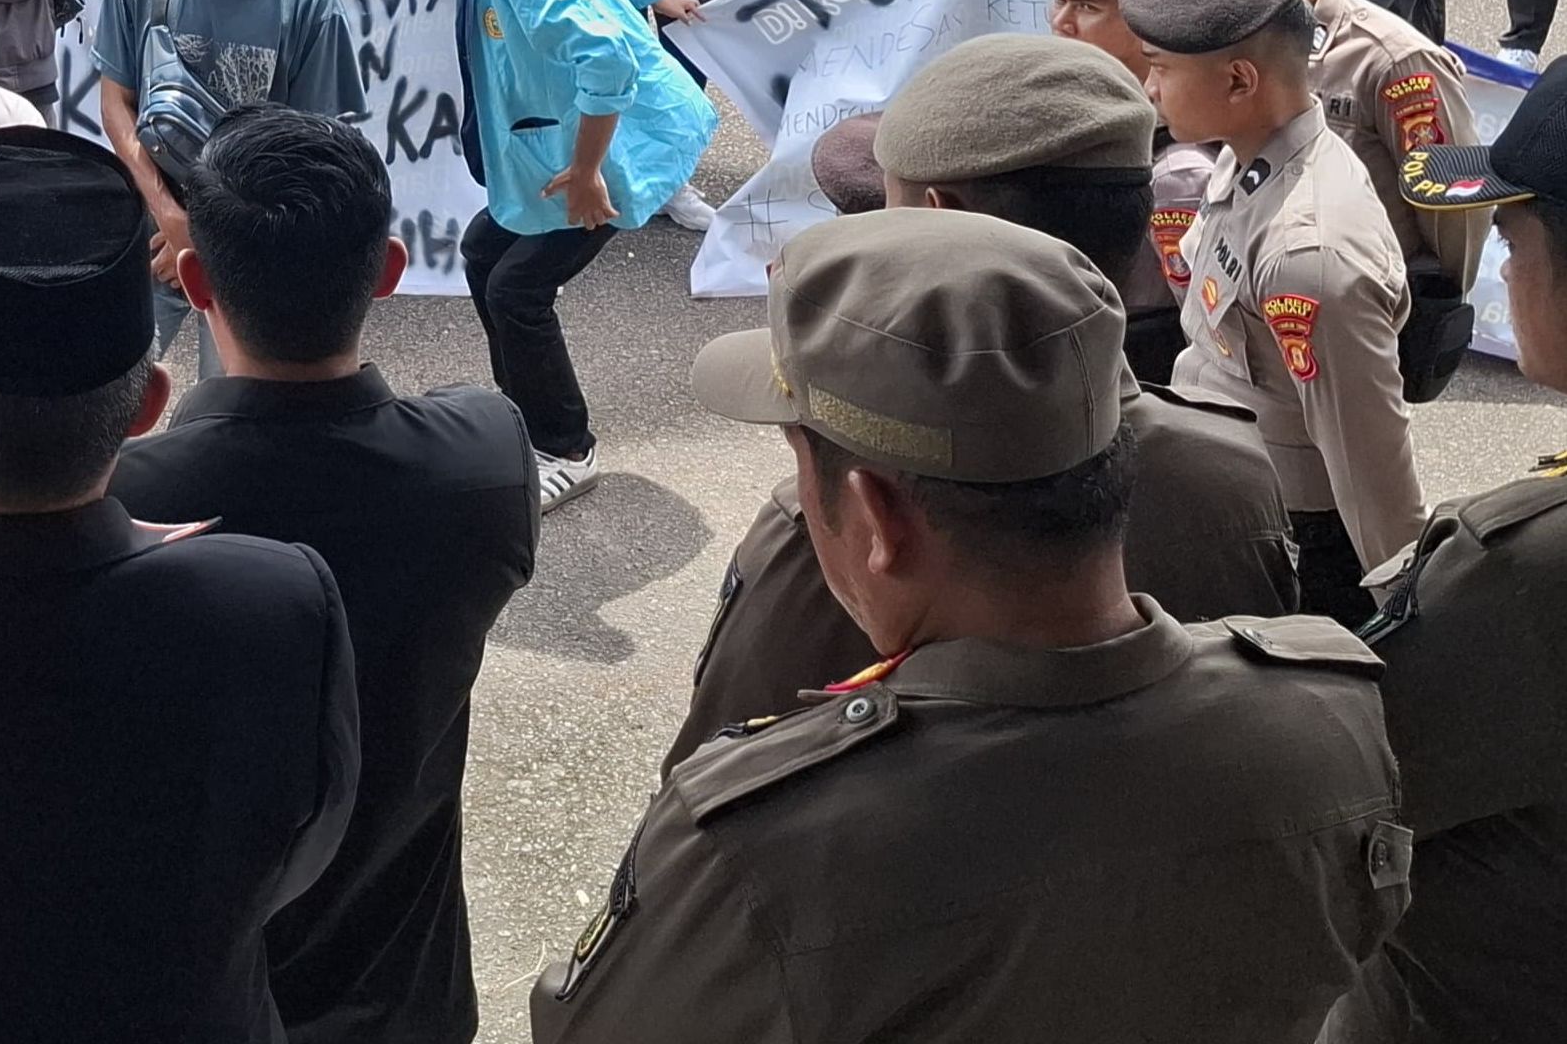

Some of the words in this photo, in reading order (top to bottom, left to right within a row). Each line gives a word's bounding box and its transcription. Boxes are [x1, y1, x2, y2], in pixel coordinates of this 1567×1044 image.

[1403, 150, 1429, 183] POL
[1411, 178, 1447, 197] PP
[1214, 236, 1243, 283] POLRI
